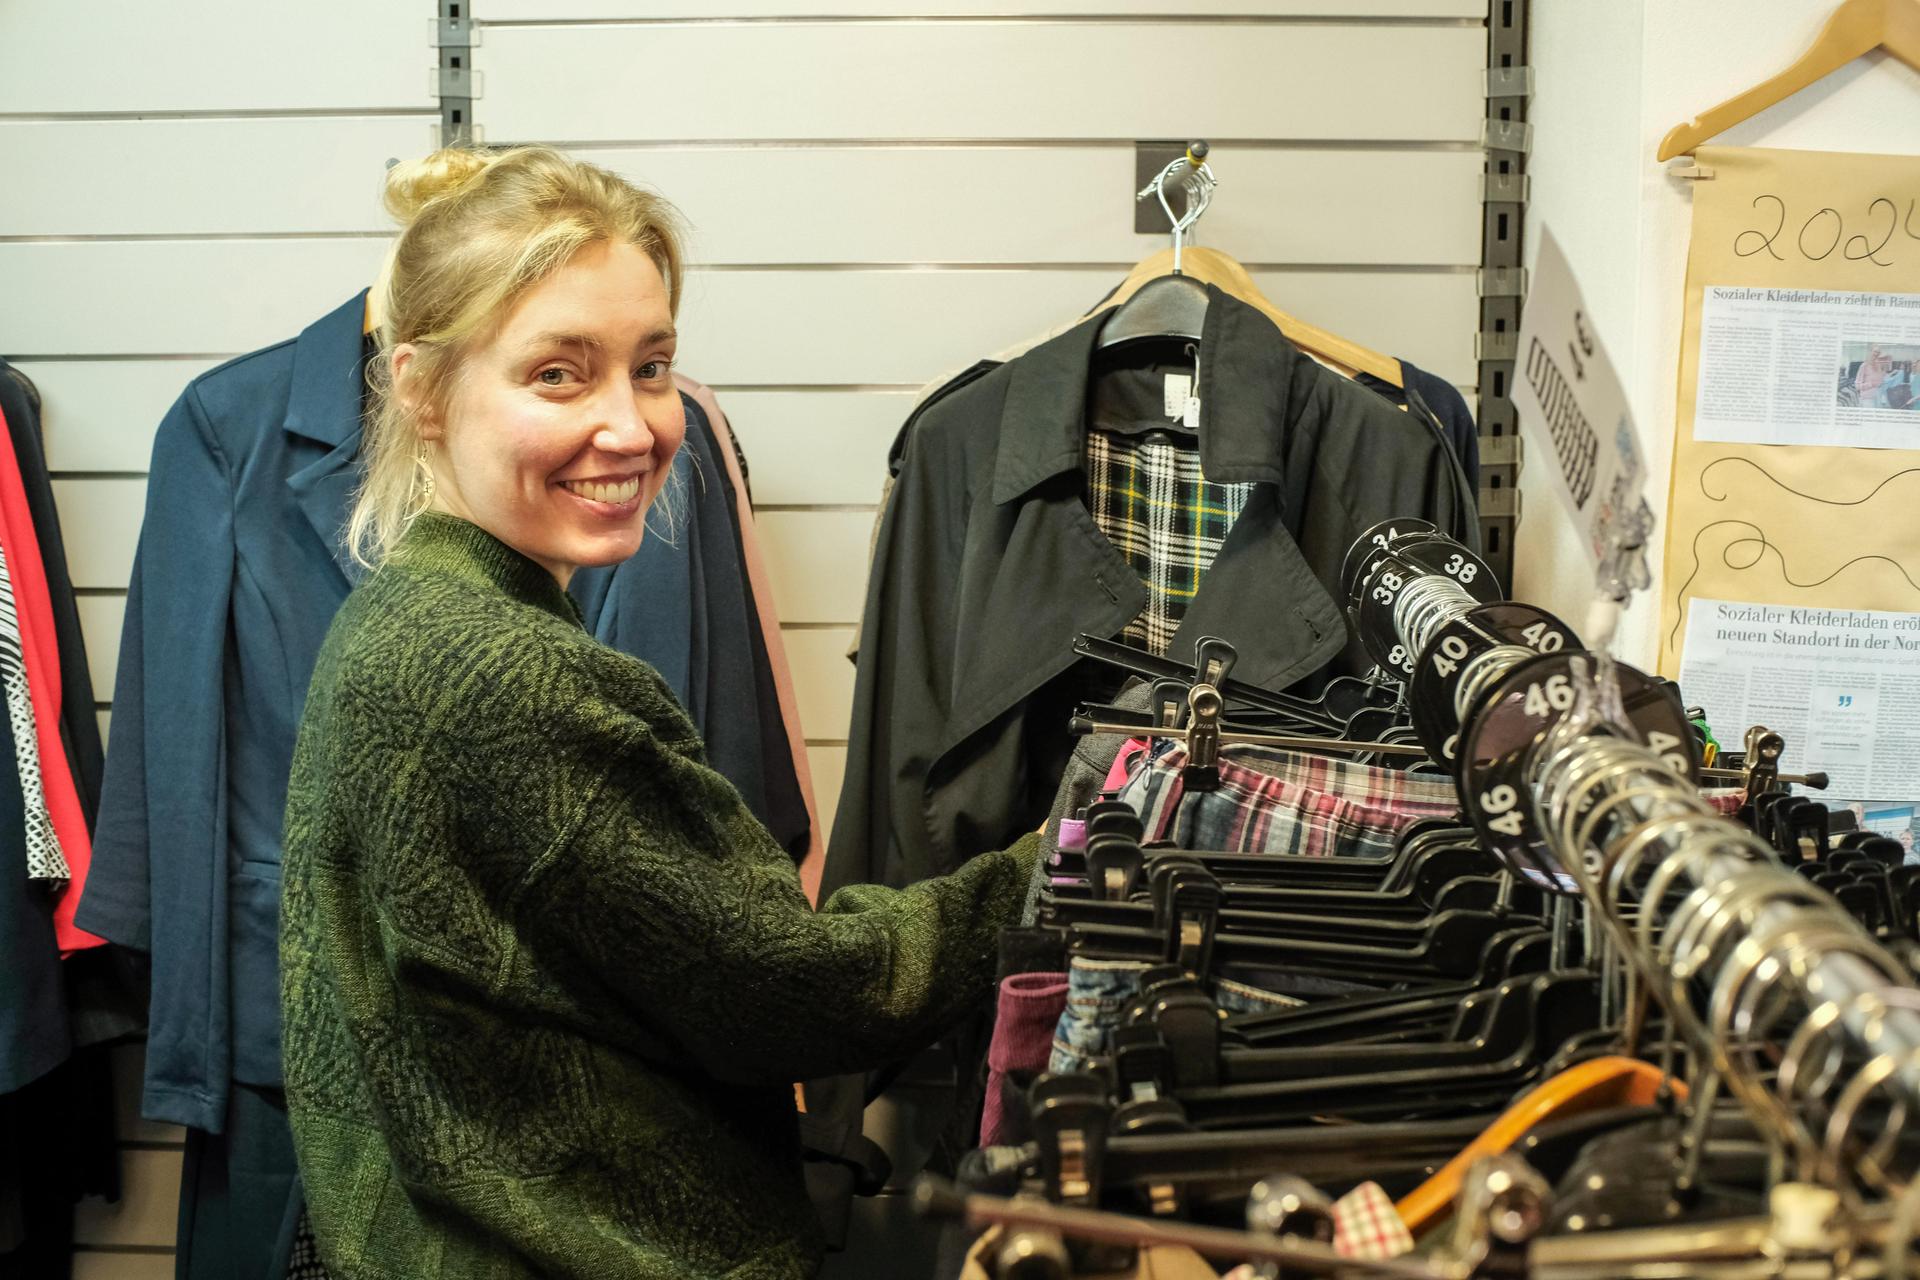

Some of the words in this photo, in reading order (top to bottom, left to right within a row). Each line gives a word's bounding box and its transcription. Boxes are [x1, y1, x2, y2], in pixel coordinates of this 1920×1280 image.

[1712, 287, 1764, 301] Sozialer
[1767, 289, 1841, 305] Kleiderladen
[1844, 293, 1872, 306] zieht
[1874, 295, 1886, 307] in
[1444, 553, 1478, 584] 38
[1372, 572, 1403, 606] 38
[1717, 604, 1785, 624] Sozialer
[1790, 609, 1889, 629] Kleiderladen
[1521, 622, 1564, 654] 40
[1716, 629, 1767, 643] neuen
[1772, 629, 1840, 648] Standort
[1844, 634, 1859, 648] in
[1864, 633, 1890, 650] der
[1432, 635, 1469, 678] 40
[1524, 674, 1576, 717] 46
[1479, 784, 1525, 836] 46
